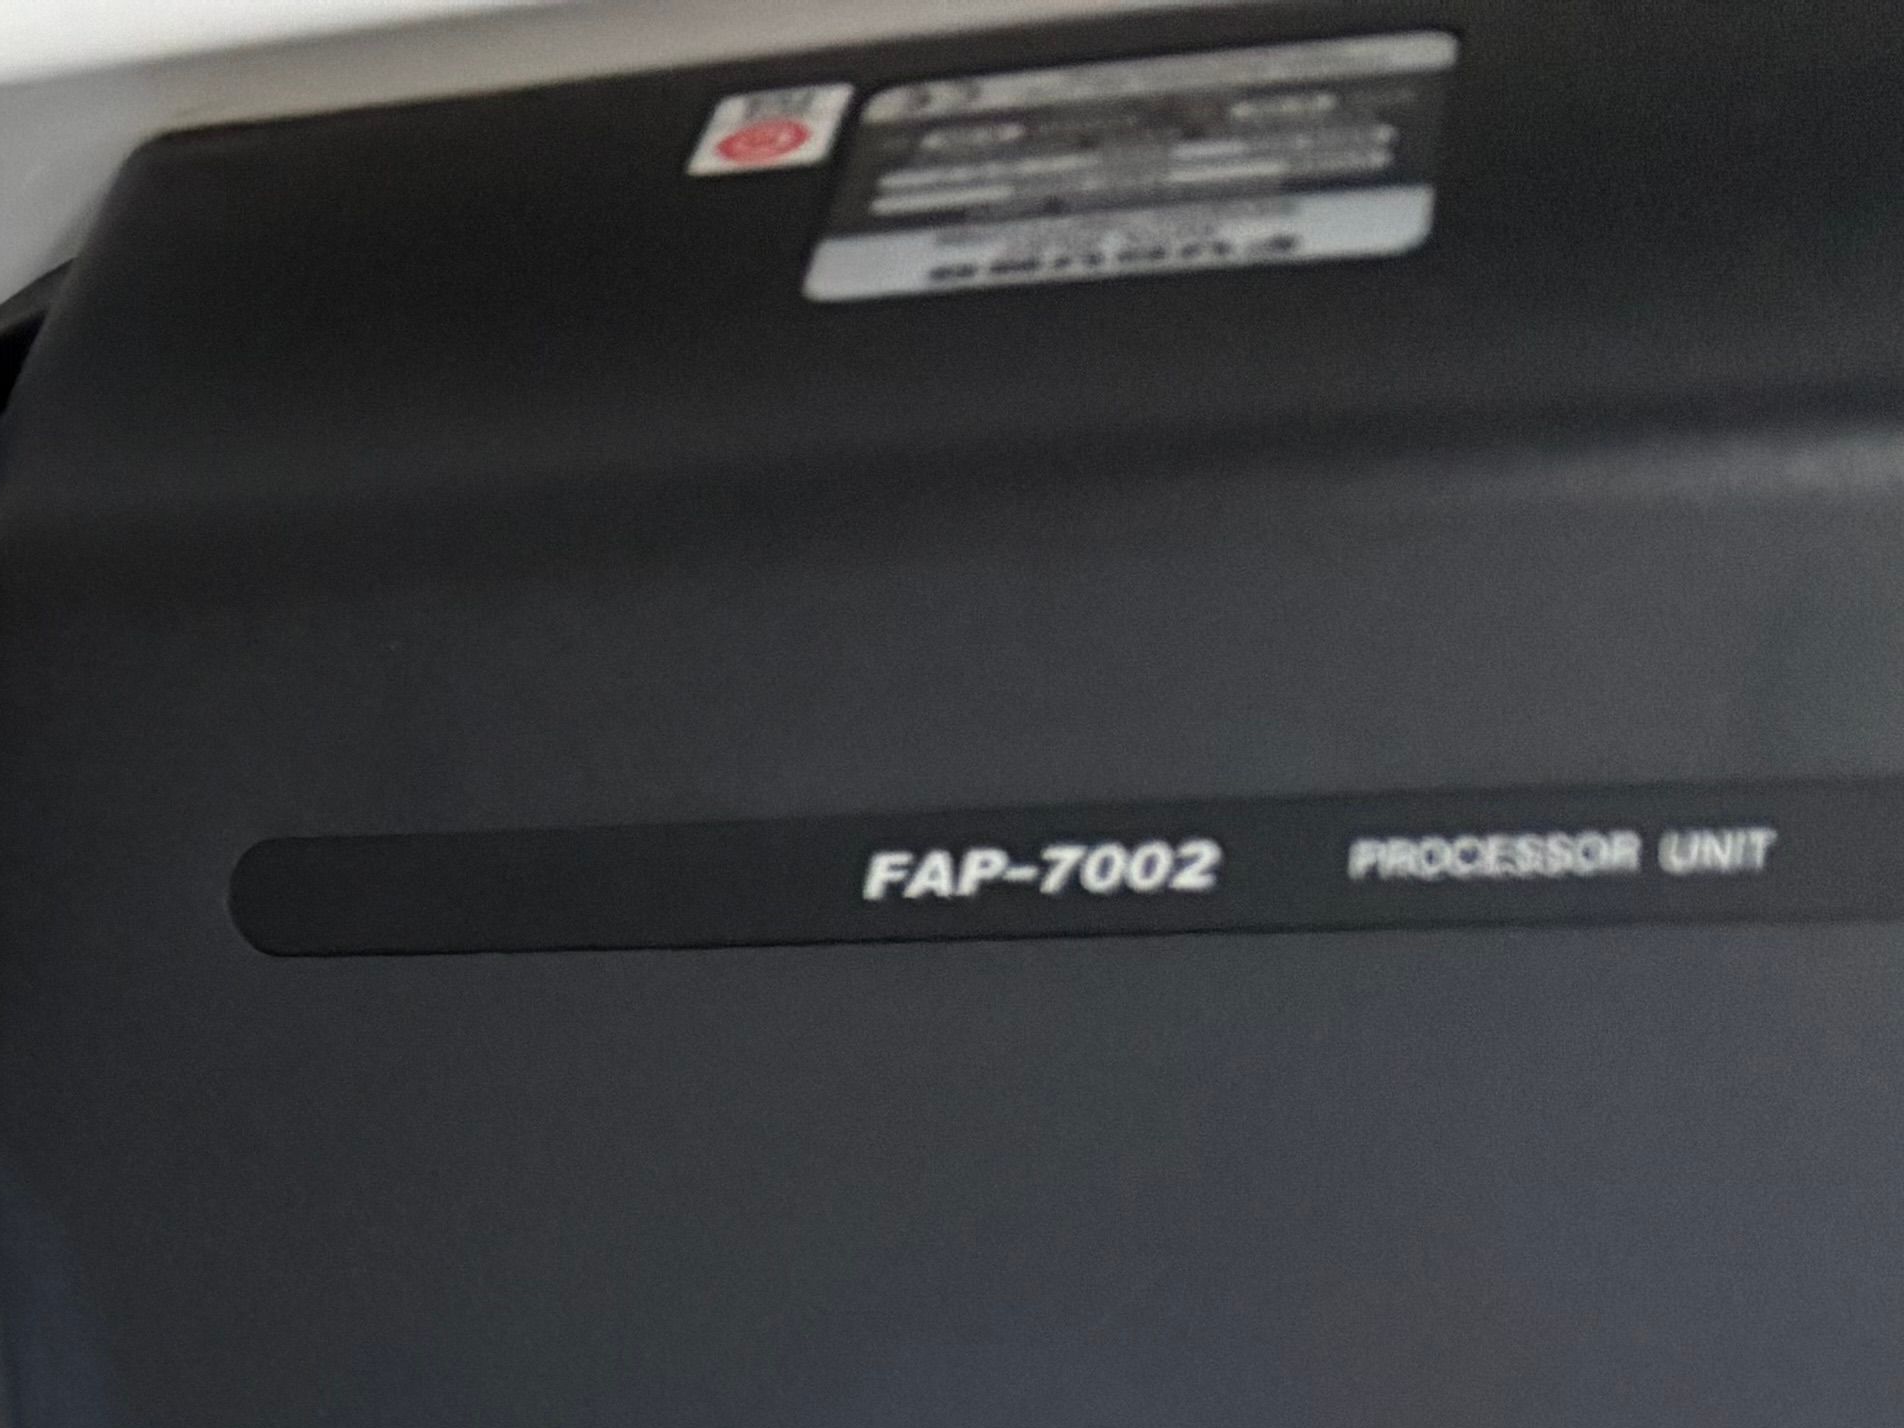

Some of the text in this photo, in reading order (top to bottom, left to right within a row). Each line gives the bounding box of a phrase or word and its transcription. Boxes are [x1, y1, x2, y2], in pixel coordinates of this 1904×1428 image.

[861, 827, 1778, 902] FAP-7002 PROCESSOR UNIT
